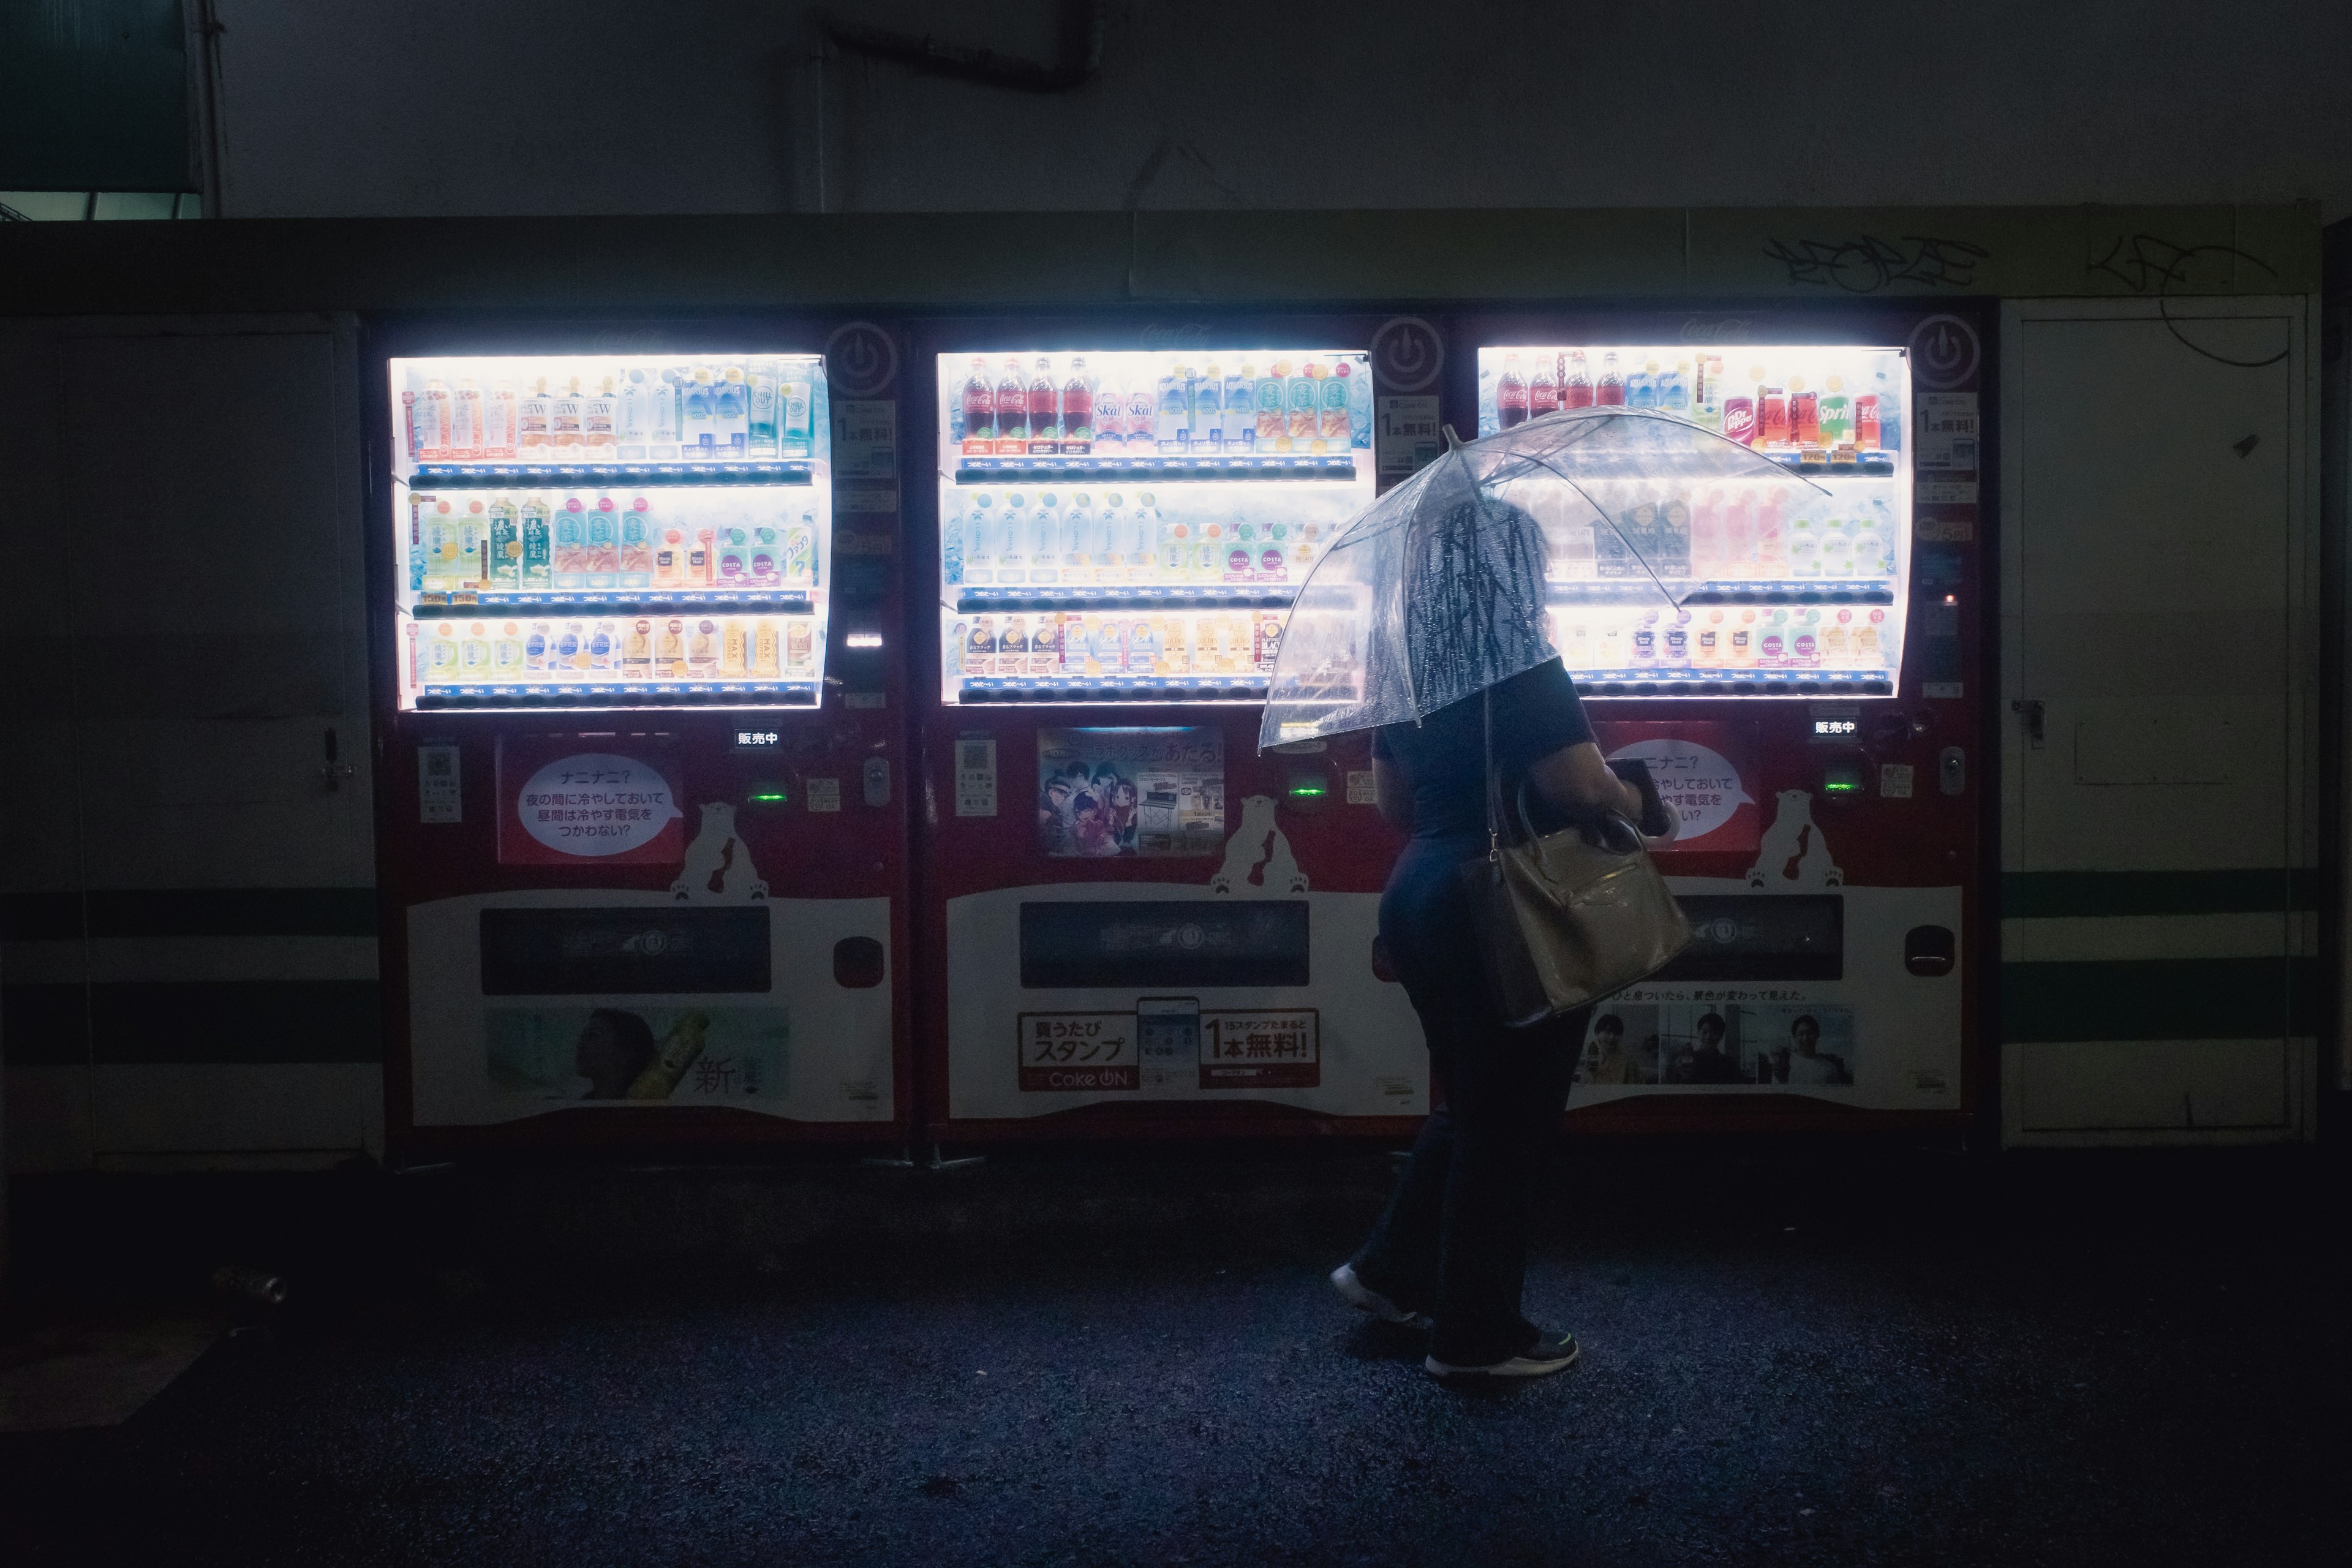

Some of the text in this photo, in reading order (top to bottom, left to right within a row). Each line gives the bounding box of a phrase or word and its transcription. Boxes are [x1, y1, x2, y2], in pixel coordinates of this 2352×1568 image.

[1159, 382, 1186, 391] AQUARIUS
[1194, 382, 1219, 391] QUARIUS
[1226, 382, 1253, 391] AQUARIUS
[1630, 378, 1657, 388] AQUARIUS
[1660, 378, 1687, 387] AQUARIUS
[967, 394, 991, 405] Coca-Cola
[1000, 394, 1024, 405] Coca-Cola
[1265, 385, 1276, 407] 麦茶
[1297, 385, 1308, 406] 麦茶
[1329, 385, 1341, 405] 麦茶
[534, 404, 546, 415] W
[567, 404, 579, 414] W
[598, 404, 611, 414] W
[1735, 410, 1747, 421] Dr
[1382, 413, 1436, 437] 1本無料!
[1727, 414, 1752, 430] Pepper
[1920, 409, 1973, 433] 1本無料!
[432, 526, 441, 546] 綾鷹
[464, 526, 473, 546] 綾鷹
[561, 521, 572, 541] 麦茶
[592, 520, 604, 540] 麦茶
[627, 519, 639, 540] 麦茶
[787, 535, 809, 560] ファンタ
[1169, 545, 1177, 562] 綾鷹
[1202, 545, 1212, 563] 綾鷹
[1815, 721, 1856, 734] 販売中
[737, 732, 778, 745] 販売中
[1646, 755, 1699, 771] ニナニ?
[560, 770, 631, 785] ナニナニ?
[1653, 777, 1732, 790] 冷やしておいて
[526, 793, 664, 806] 夜の間に冷やしておいて
[1662, 794, 1722, 806] やす電気を
[538, 809, 652, 822] 昼間は冷やす電気を
[559, 824, 631, 837] つかわない?
[1036, 1020, 1101, 1039] 買うたび
[1035, 1038, 1125, 1062] スタンプ
[695, 1056, 735, 1095] 新
[1049, 1072, 1096, 1088] Coke
